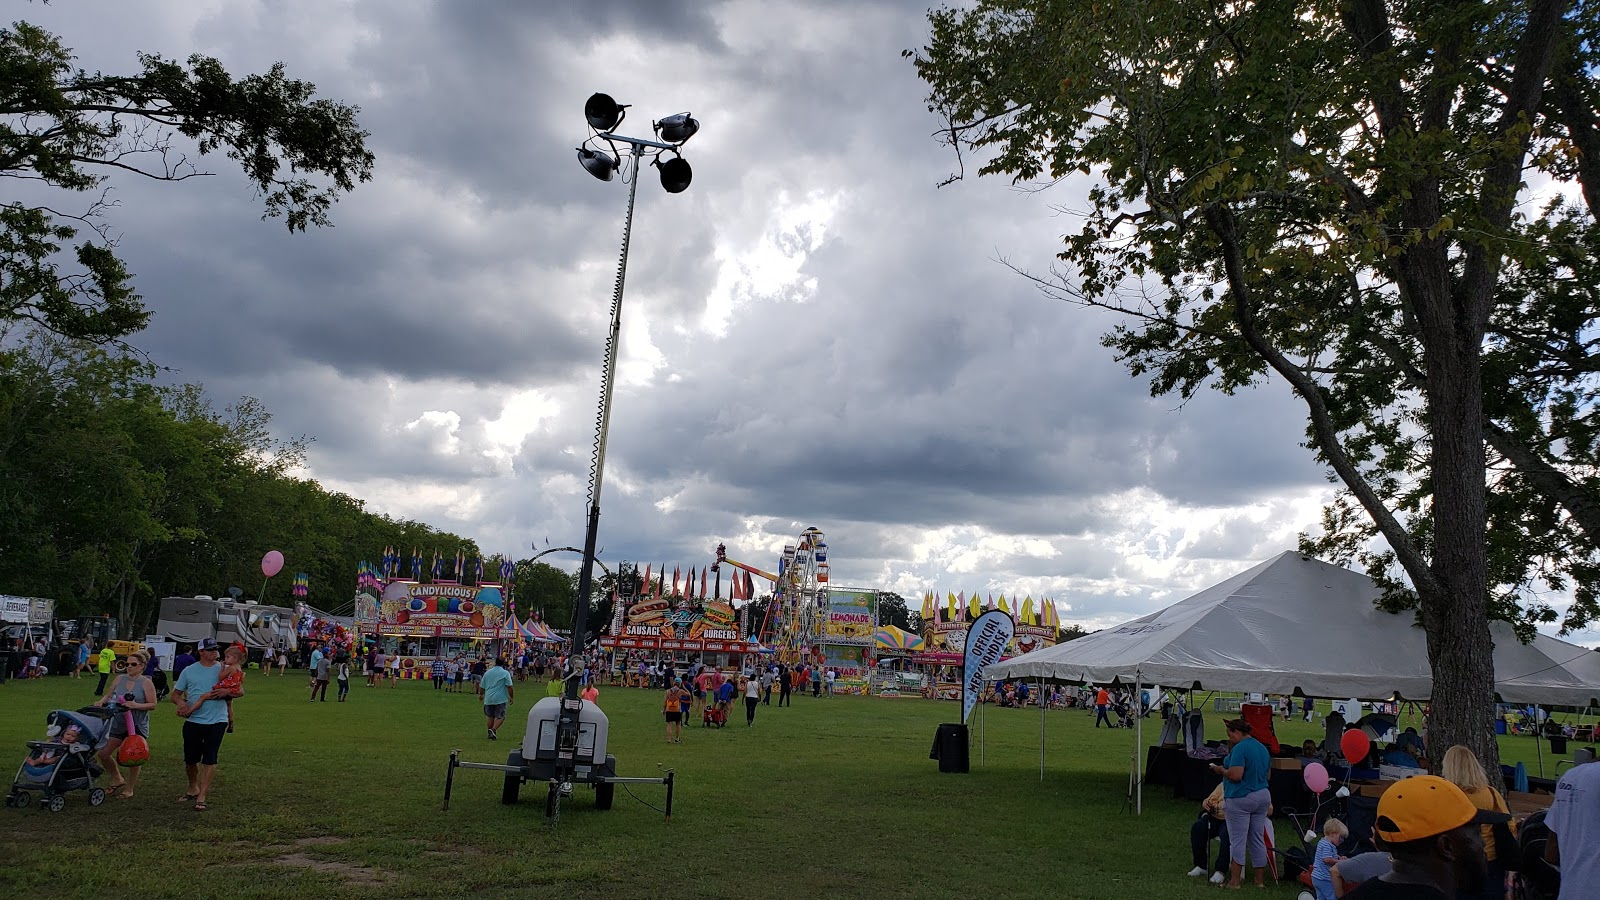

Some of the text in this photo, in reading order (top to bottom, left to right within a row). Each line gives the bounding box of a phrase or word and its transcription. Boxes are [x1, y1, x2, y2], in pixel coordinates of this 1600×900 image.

[6, 601, 28, 612] BEVERAGES
[663, 611, 700, 627] Grill
[830, 612, 869, 623] LEMONADE
[626, 625, 661, 636] SAUSAGE
[938, 623, 964, 631] FUNNEL
[703, 629, 737, 640] BURGERS
[971, 618, 1000, 656] OFFICIAL
